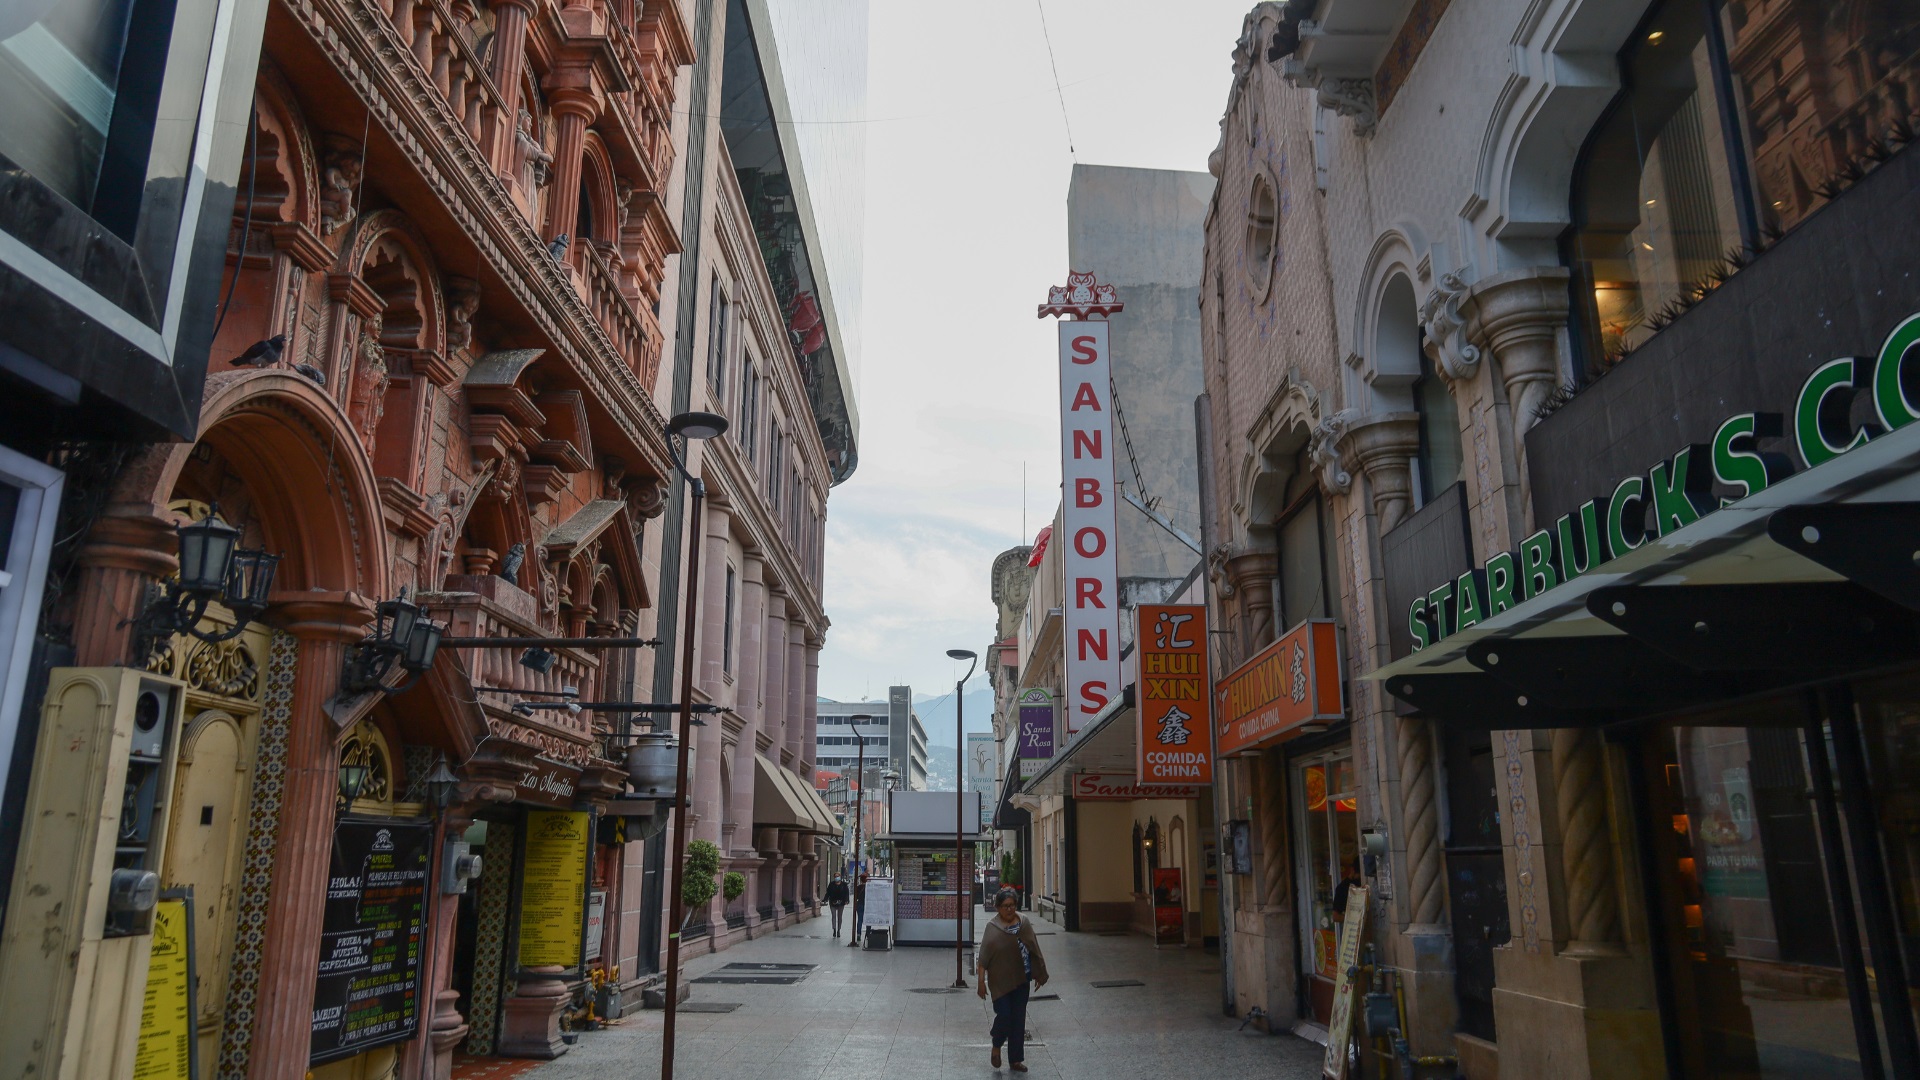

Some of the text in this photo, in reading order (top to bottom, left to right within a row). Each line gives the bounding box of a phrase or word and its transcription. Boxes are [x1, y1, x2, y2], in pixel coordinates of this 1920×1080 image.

[1071, 335, 1108, 714] SANBORNS
[1408, 411, 1768, 654] STARBUCKS
[1154, 611, 1195, 649] 汇
[1145, 653, 1200, 674] HUI
[1145, 678, 1200, 701] XIN
[1229, 646, 1288, 723] HUI XIN
[1023, 722, 1051, 736] Santa
[1156, 705, 1192, 745] 鑫
[1239, 707, 1280, 740] COMIDA CHINA
[1027, 733, 1051, 747] Rosa
[1146, 752, 1207, 764] COMIDA
[1152, 764, 1201, 777] CHINA
[519, 770, 574, 801] Las Monjitas
[1079, 776, 1195, 796] Sanborns
[1706, 855, 1729, 867] PARA
[1729, 855, 1740, 866] TU
[330, 876, 361, 888] HOLA!
[328, 889, 358, 899] TENEMOS
[336, 936, 362, 948] PRUEBA
[331, 946, 362, 959] NUESTRA
[318, 956, 368, 971] ESPECIALIDAD
[312, 1005, 342, 1021] AMBIEN
